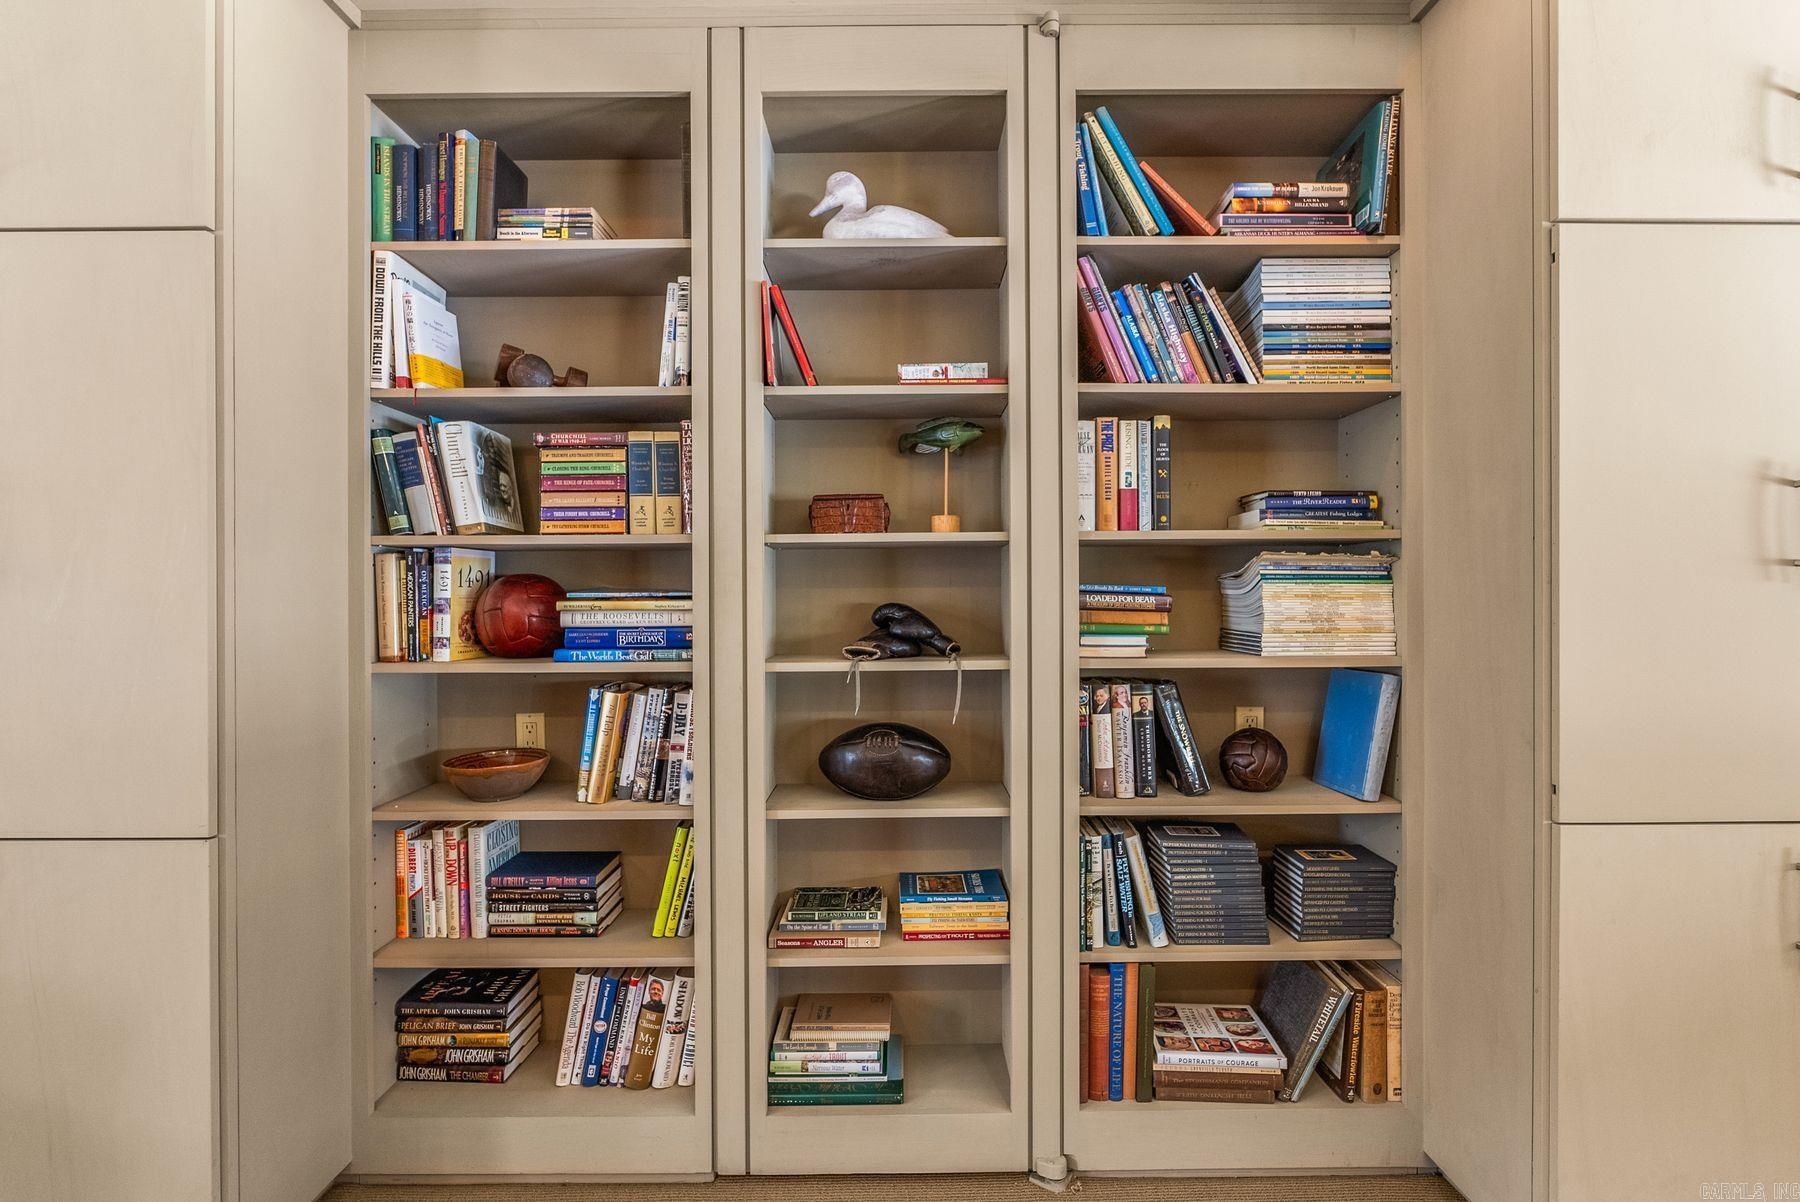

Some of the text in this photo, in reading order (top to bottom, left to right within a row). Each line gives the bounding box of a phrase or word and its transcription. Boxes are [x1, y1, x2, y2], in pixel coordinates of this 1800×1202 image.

[1386, 101, 1400, 176] THE LIVING RIVER
[384, 178, 390, 186] IN
[1080, 162, 1090, 190] Fishing
[374, 296, 384, 320] FROM
[1091, 287, 1108, 312] GIANTS
[373, 324, 383, 342] THE
[1126, 315, 1139, 338] ALASKA
[1146, 311, 1160, 340] ALASKA
[1155, 292, 1188, 363] Alaska Highway
[372, 343, 382, 366] HILLS
[1210, 332, 1219, 350] ALASKA
[1102, 420, 1114, 452] THE PRIZE
[444, 424, 468, 478] Churchill
[421, 570, 427, 582] ON
[440, 570, 450, 592] 1491
[458, 565, 490, 592] 1491
[618, 634, 664, 646] BIRTHDAYS
[570, 650, 655, 662] The Best Golf
[602, 715, 614, 737] Help
[658, 704, 672, 737] Victors
[674, 702, 688, 736] D-DAY
[1120, 710, 1134, 784] Benjamin Franklin
[1174, 710, 1195, 764] THE SNOWBALL
[668, 760, 676, 792] AMBROSE
[445, 838, 458, 886] UP DOWN
[1118, 884, 1128, 912] WATER
[1124, 875, 1133, 910] FISHING
[674, 980, 688, 1020] SHADOW
[401, 1020, 433, 1029] PELICAN
[436, 1021, 457, 1029] BRIEF
[562, 980, 586, 1070] Bob Woodward The Agenda
[639, 1020, 661, 1030] Clinton
[646, 1013, 658, 1021] Bill
[1309, 996, 1338, 1042] WHITETAIL
[400, 1035, 446, 1046] JOHN GRISHAM
[608, 1014, 622, 1049] COMMAND
[639, 1032, 656, 1046] My
[1112, 976, 1122, 1091] THE NATURE OF LIFE
[1349, 1002, 1362, 1084] Fireside Waterfowler
[445, 1049, 494, 1063] JOHN GRISHAM
[634, 1044, 654, 1056] Life
[400, 1066, 489, 1080] JOHN GRISHAM THE CHAMBER
